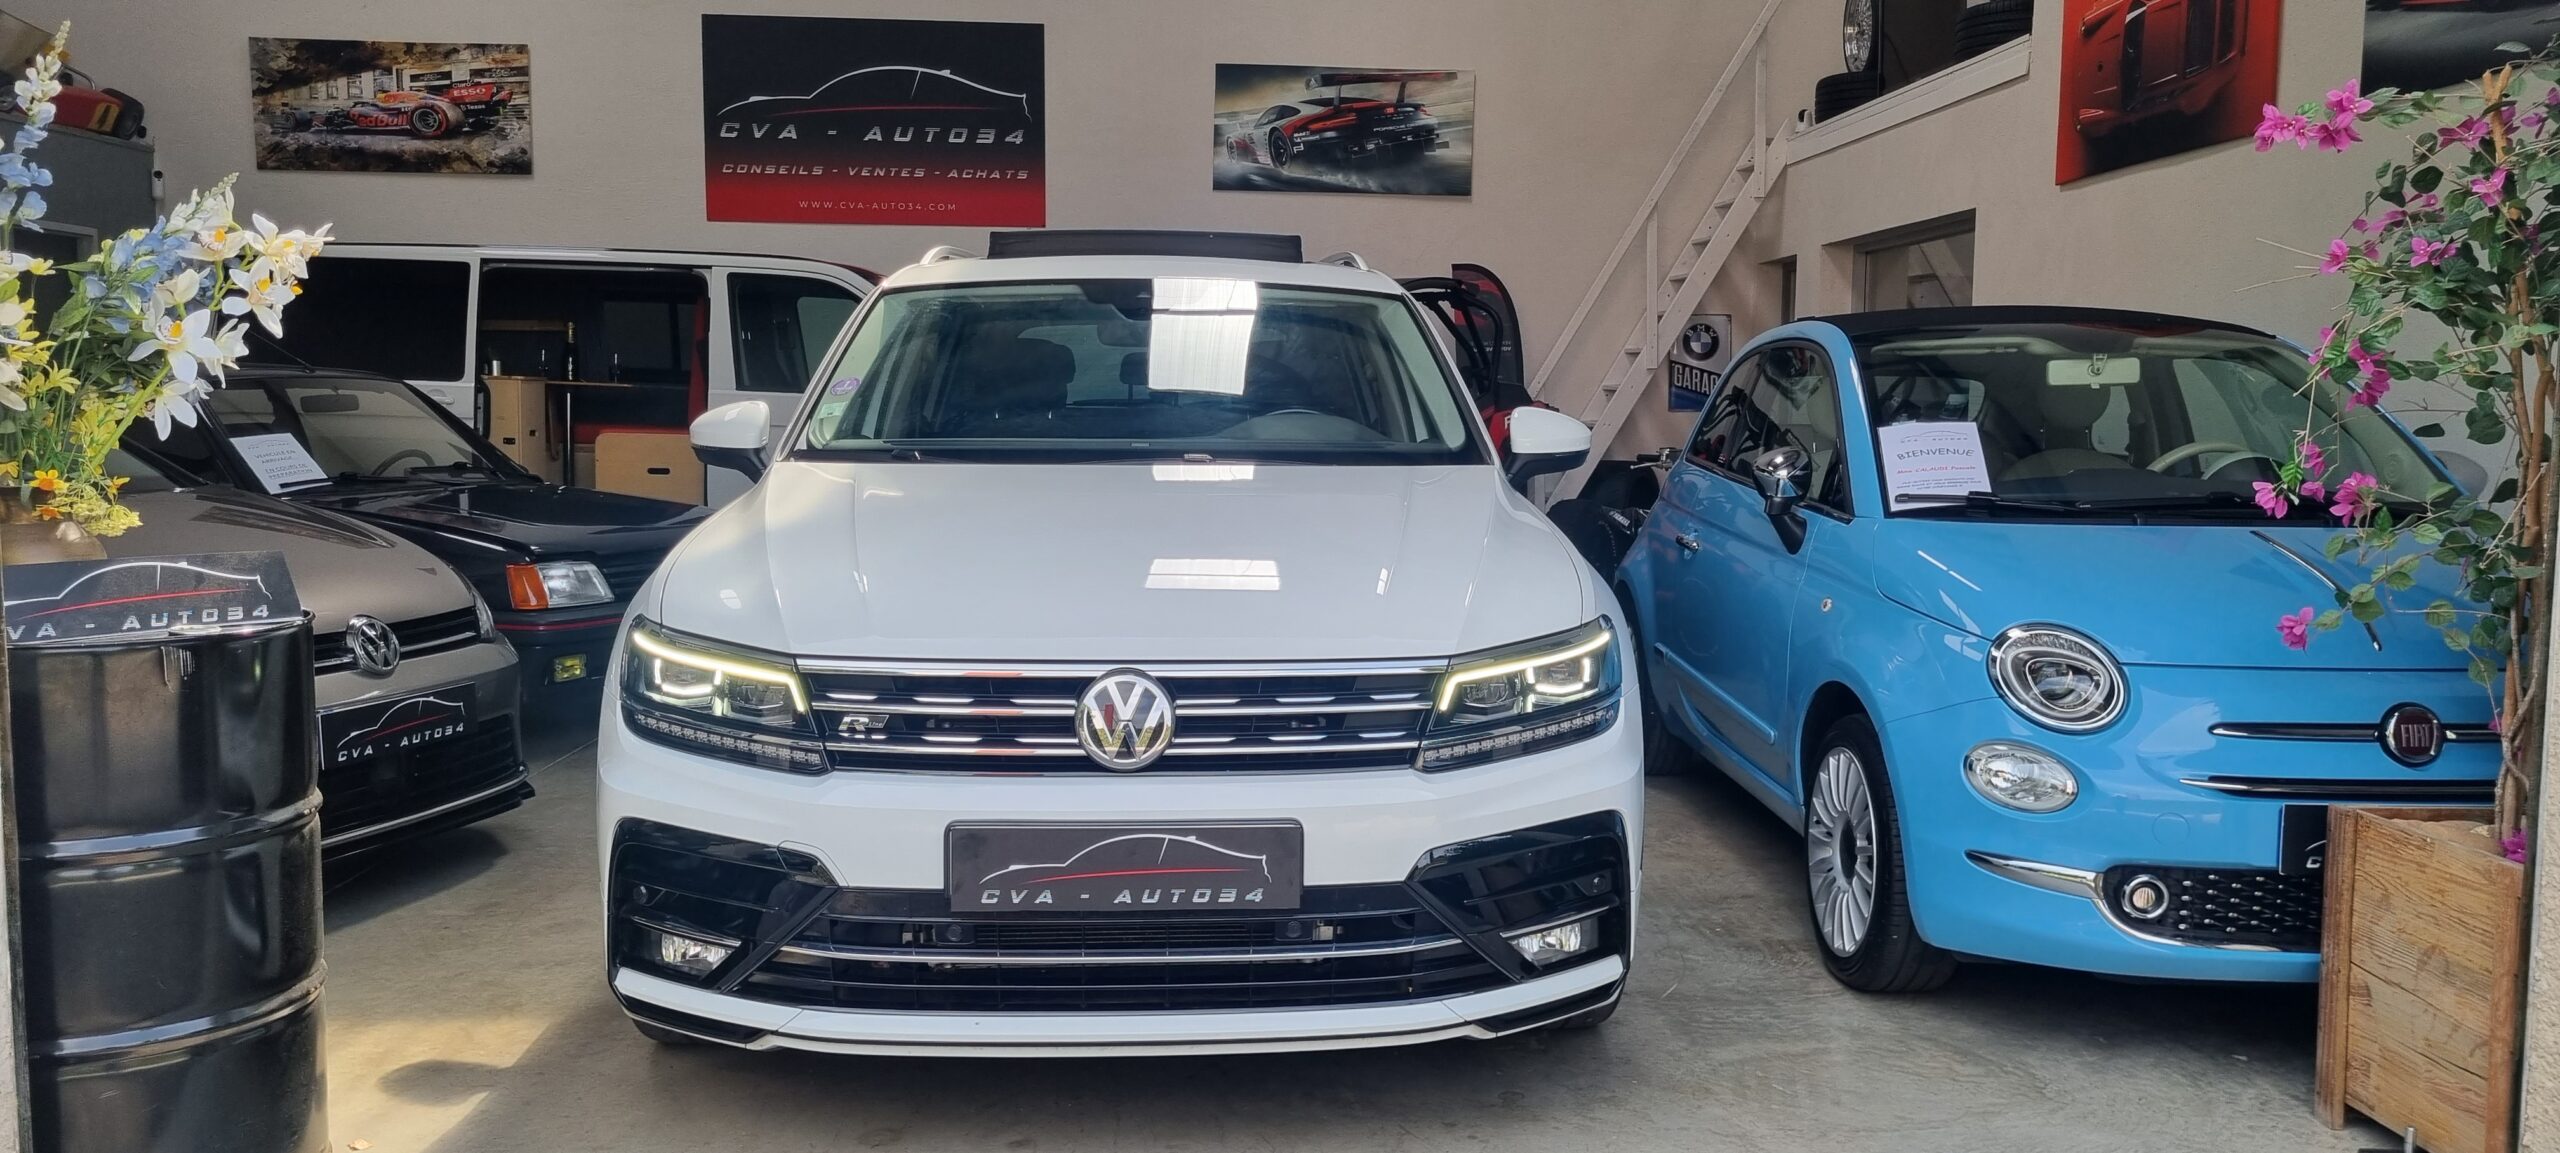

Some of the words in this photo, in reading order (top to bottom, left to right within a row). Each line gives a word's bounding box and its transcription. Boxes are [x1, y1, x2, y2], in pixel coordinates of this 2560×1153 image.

[720, 122, 798, 140] CVA
[863, 126, 1025, 145] AUTO34
[722, 164, 824, 176] CONSEILS
[848, 167, 926, 178] VENTES
[947, 169, 1029, 180] ACHATS
[799, 201, 957, 211] WWW.CVA-AUTO34.COM
[1685, 324, 1717, 337] BMW
[1897, 448, 1975, 460] BIENVENUE
[122, 604, 270, 630] AUTO34
[337, 745, 373, 762] CVA
[400, 723, 464, 747] AUTO34
[2400, 724, 2430, 748] FIAT
[981, 889, 1053, 904] CVA
[1113, 888, 1264, 904] AUTO34
